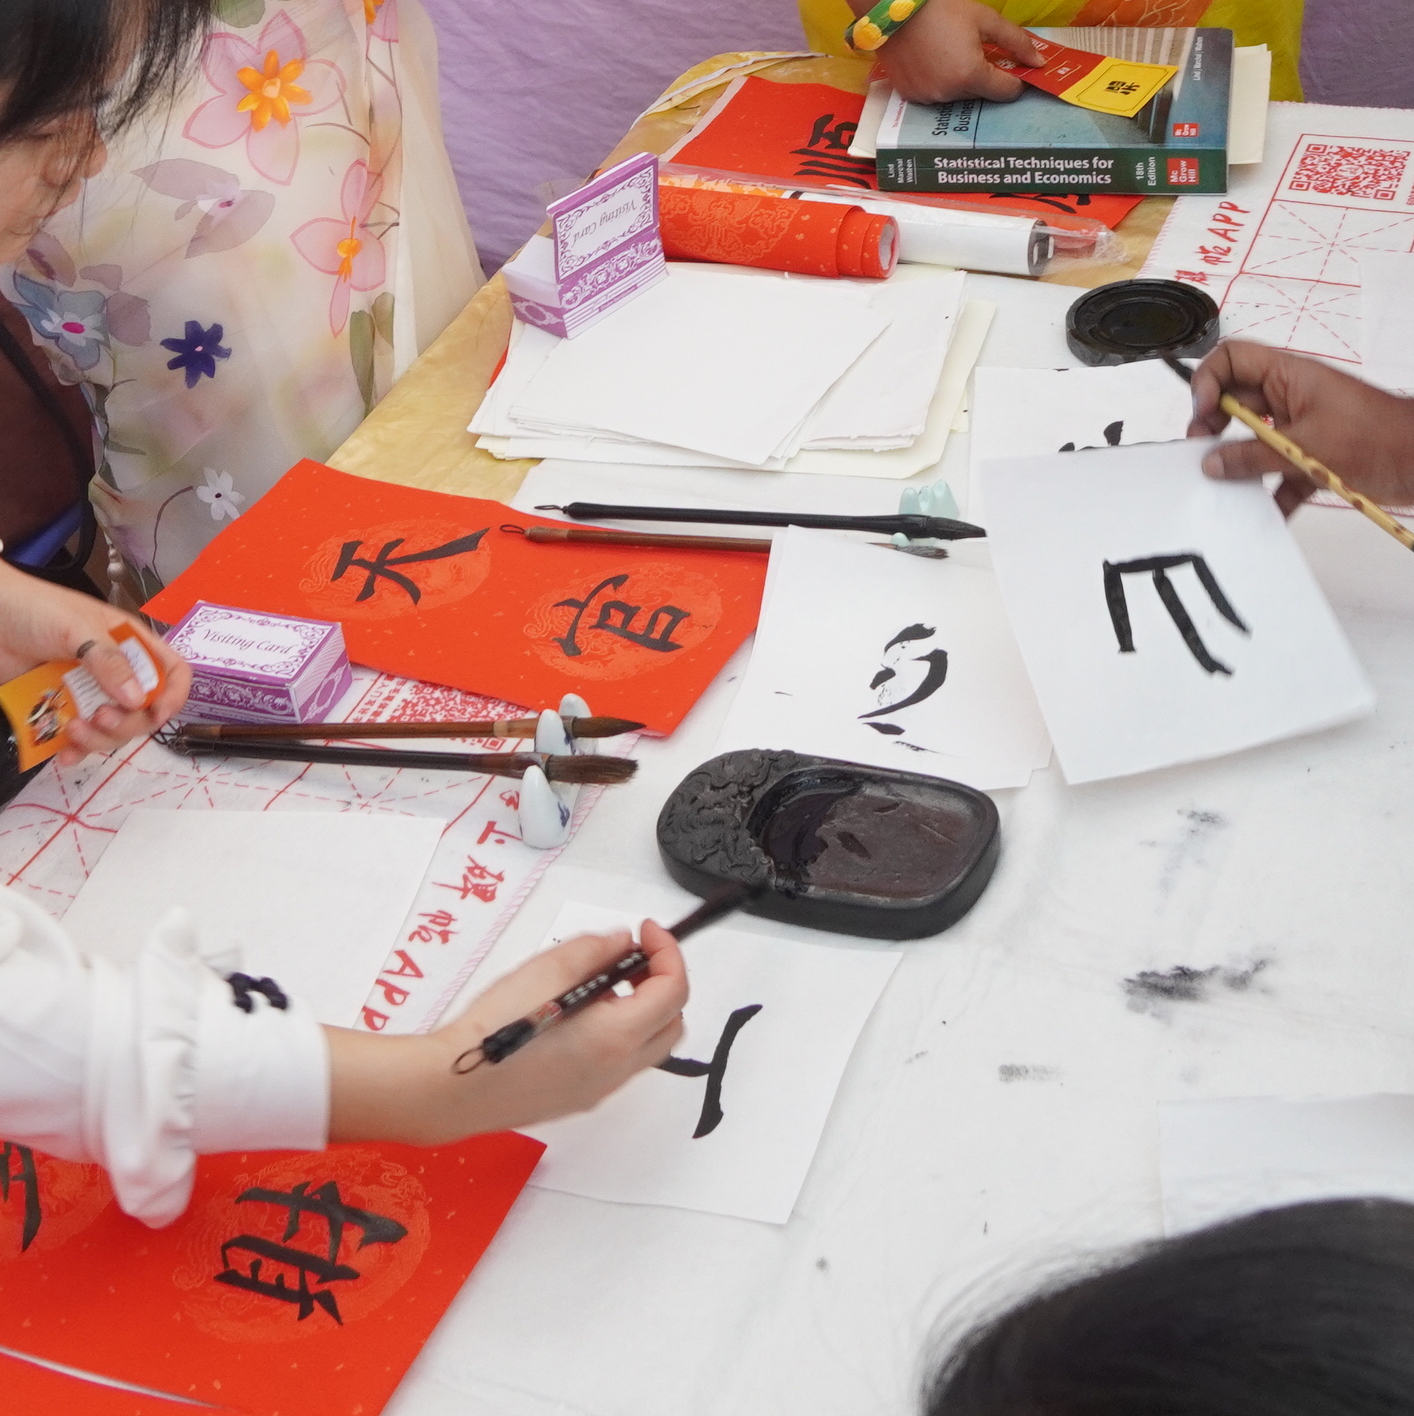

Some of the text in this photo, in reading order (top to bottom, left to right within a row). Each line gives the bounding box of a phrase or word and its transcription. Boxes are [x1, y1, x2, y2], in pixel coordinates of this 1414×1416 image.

[934, 156, 1114, 172] Statistical Techniques for
[1136, 162, 1144, 180] 18th
[1148, 156, 1157, 186] Edition
[938, 171, 1112, 184] Business and Economics
[1170, 169, 1179, 183] Mc
[1188, 168, 1197, 183] Hill
[570, 199, 638, 248] Visiting Card
[202, 628, 298, 655] Visiting Card
